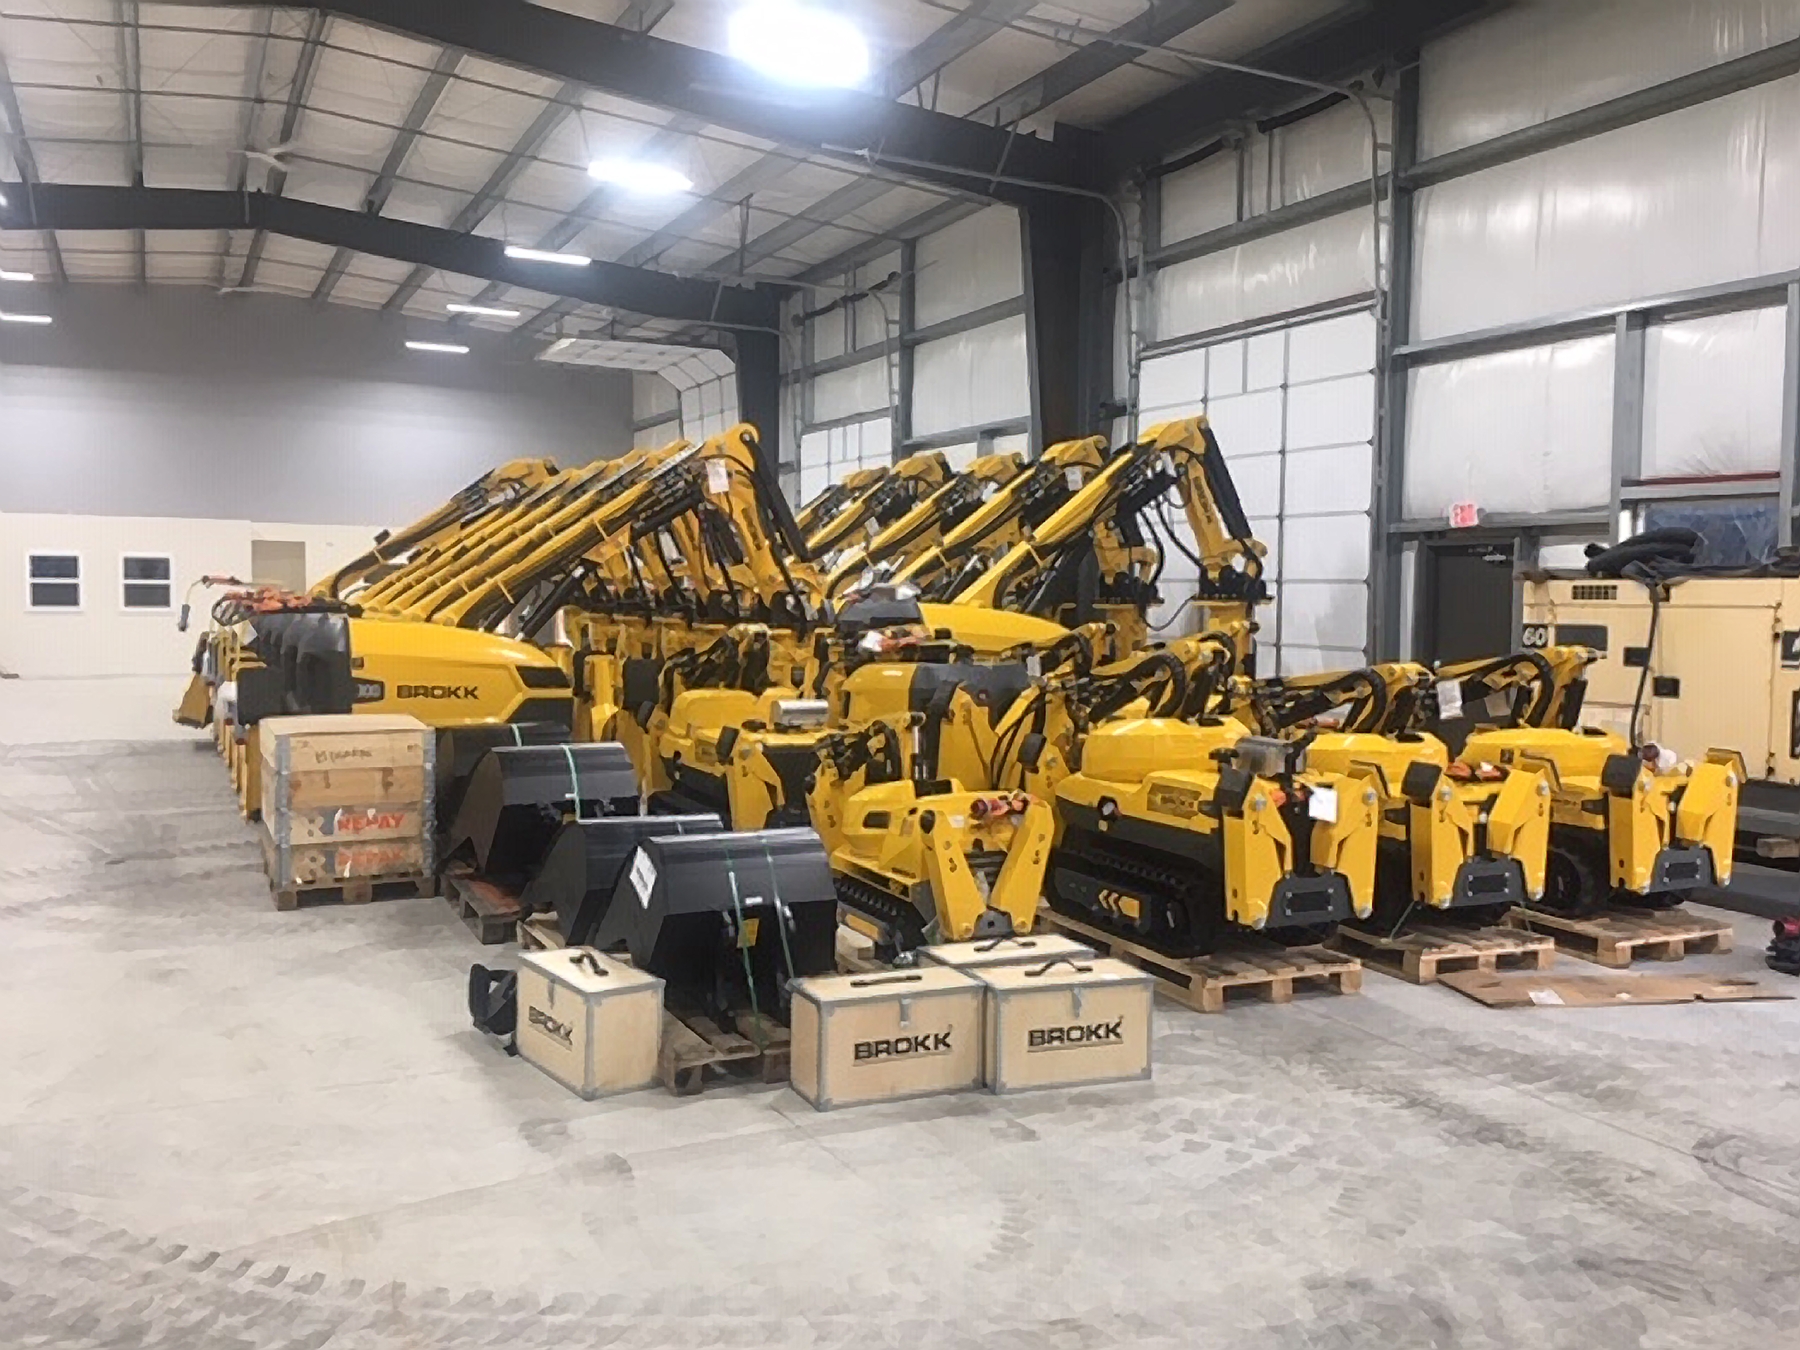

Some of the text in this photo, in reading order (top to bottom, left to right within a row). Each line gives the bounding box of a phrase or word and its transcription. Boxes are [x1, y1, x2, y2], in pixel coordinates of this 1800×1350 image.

[1522, 626, 1547, 646] 60
[397, 684, 479, 699] BROKK
[854, 1031, 951, 1060] BROKK
[1028, 1021, 1122, 1047] BROKK
